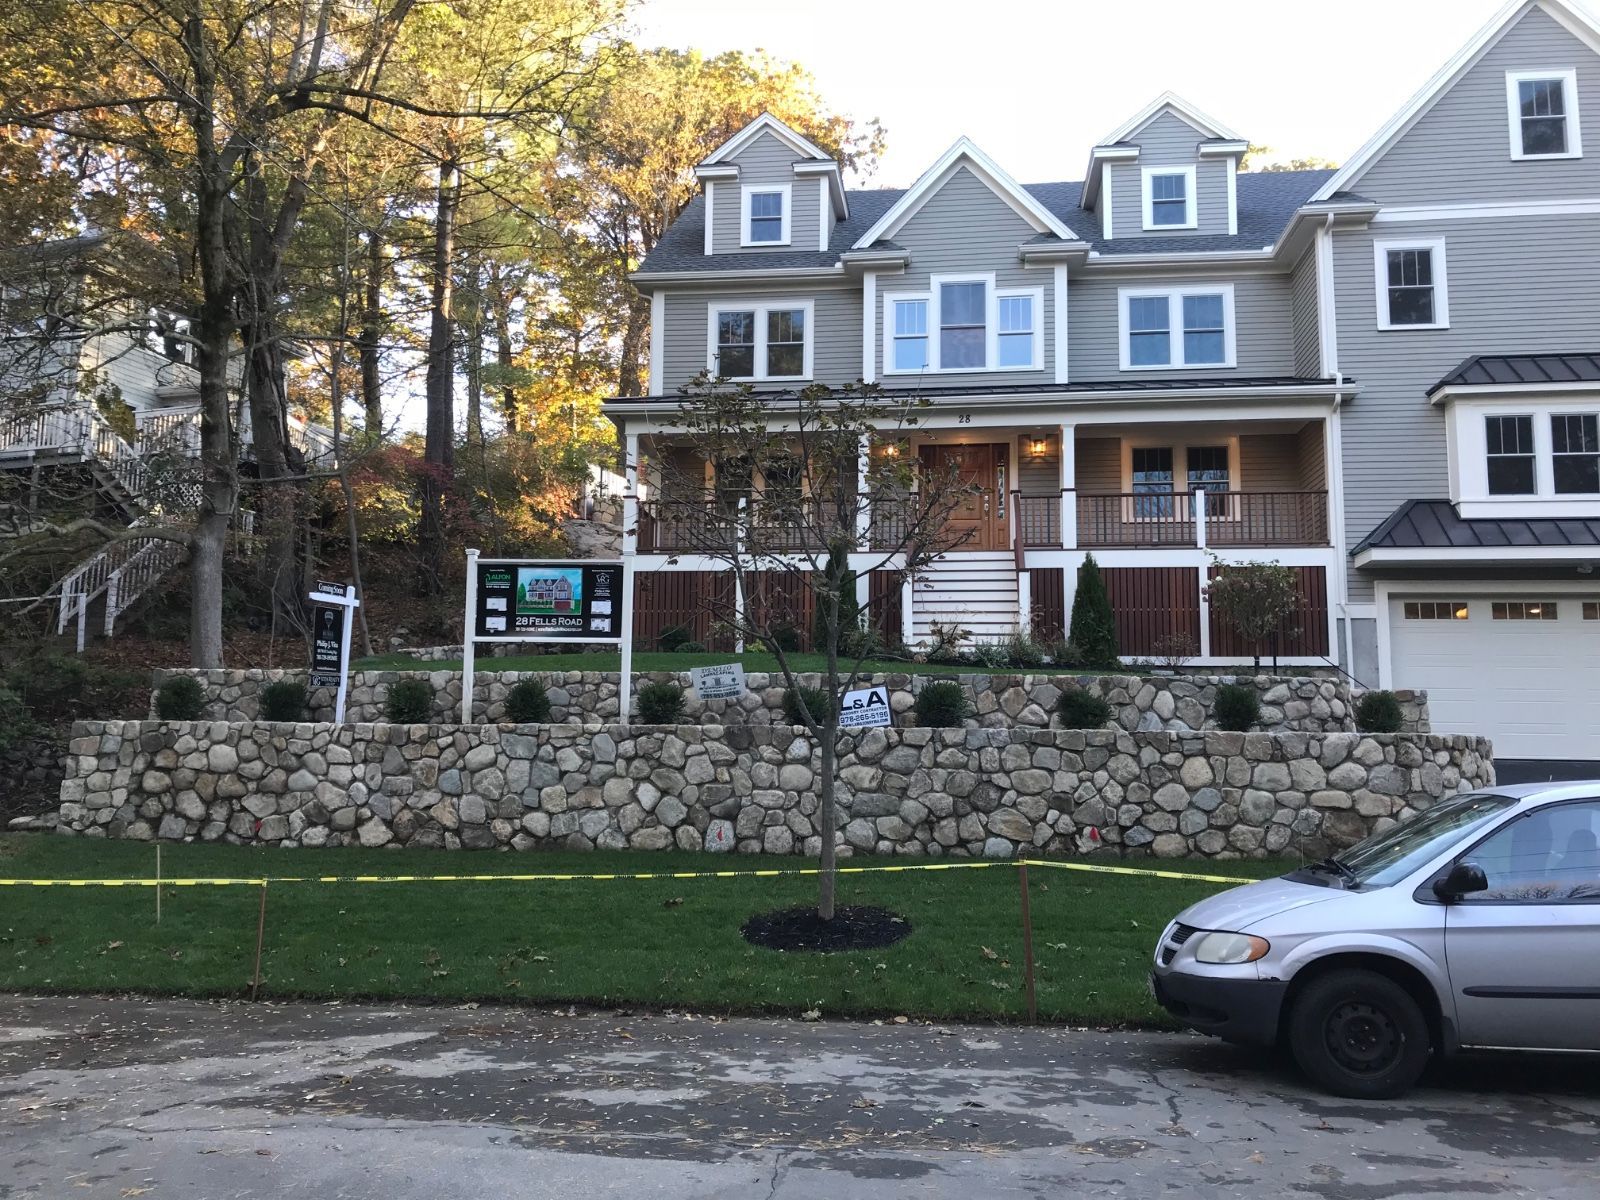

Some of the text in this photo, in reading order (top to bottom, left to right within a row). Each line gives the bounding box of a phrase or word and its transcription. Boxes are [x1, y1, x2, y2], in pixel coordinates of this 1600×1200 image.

[958, 414, 971, 424] 28
[515, 617, 583, 625] 28 FELLS ROAD
